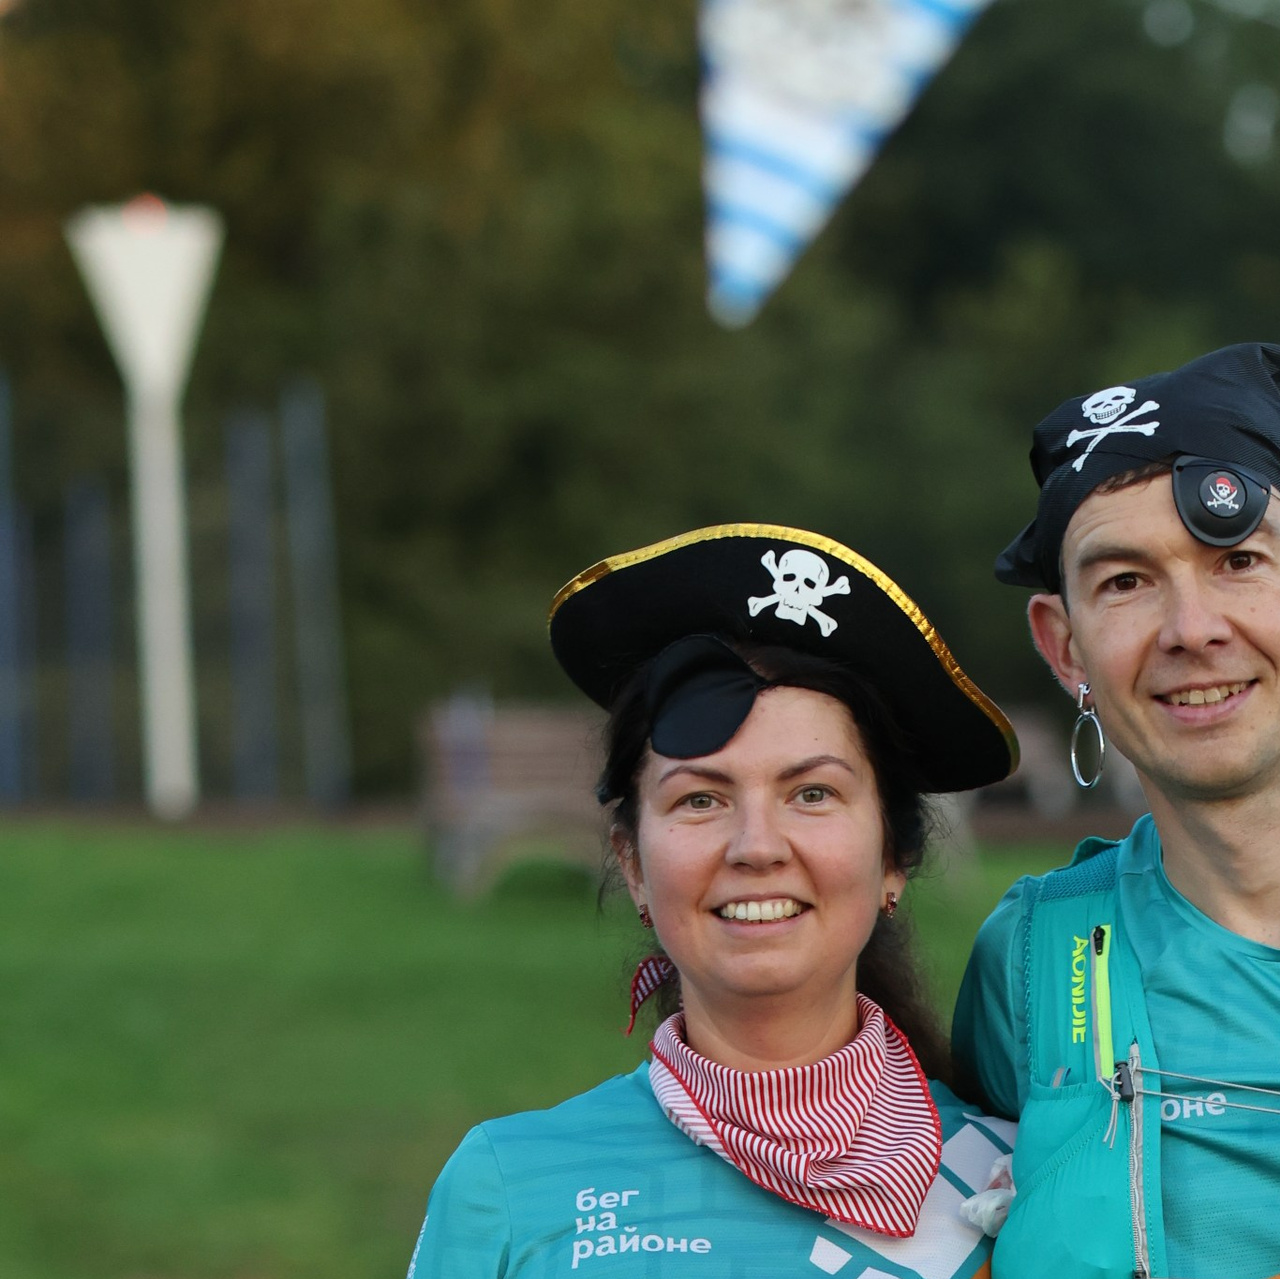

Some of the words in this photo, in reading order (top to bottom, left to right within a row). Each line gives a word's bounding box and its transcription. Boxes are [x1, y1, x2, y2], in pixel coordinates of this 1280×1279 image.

[1071, 935, 1089, 1044] AONIJIE
[575, 1187, 640, 1212] бег
[575, 1211, 618, 1235] на
[571, 1226, 712, 1269] районе
